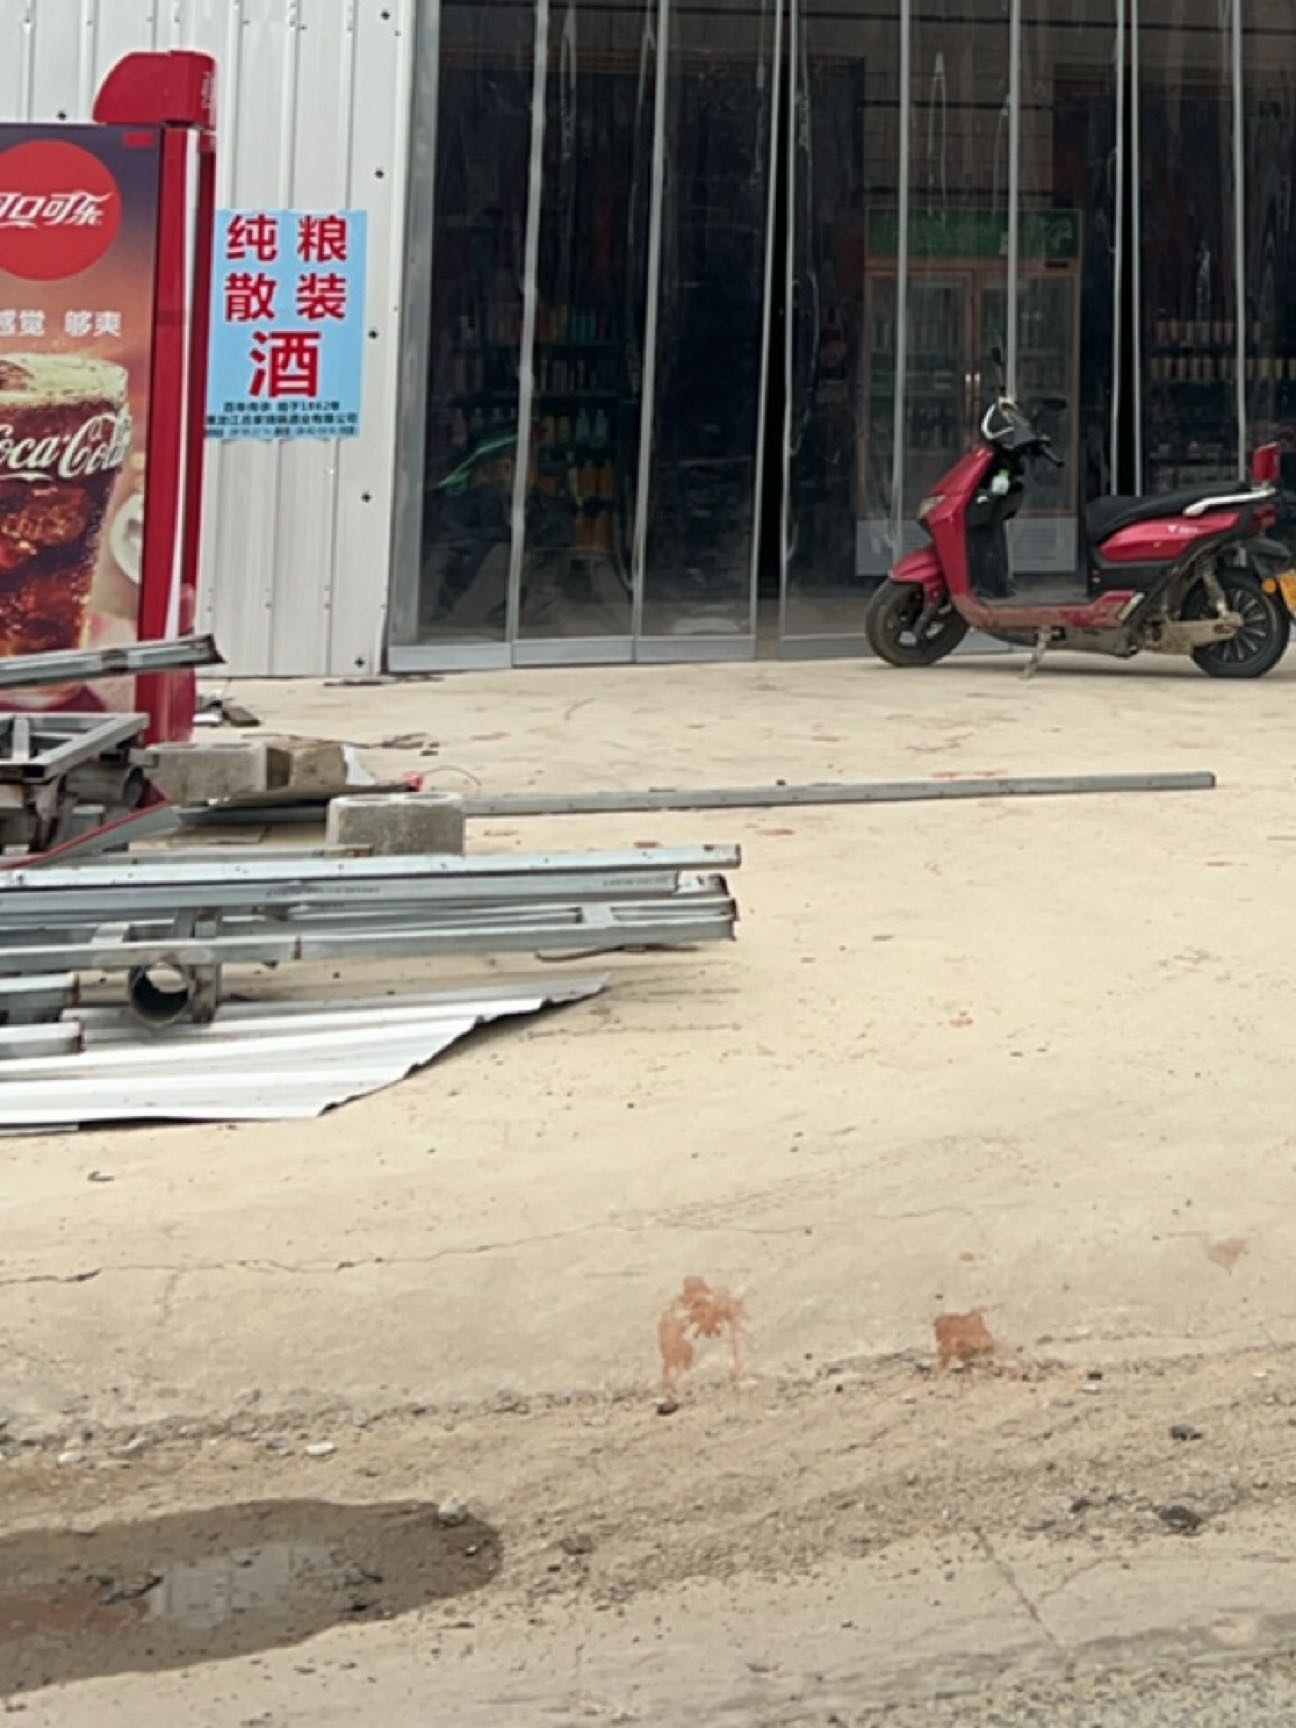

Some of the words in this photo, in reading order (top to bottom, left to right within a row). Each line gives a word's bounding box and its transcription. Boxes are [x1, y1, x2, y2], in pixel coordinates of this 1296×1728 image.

[225, 213, 348, 263] 纯粮
[224, 272, 347, 322] 散装
[249, 331, 322, 398] 酒
